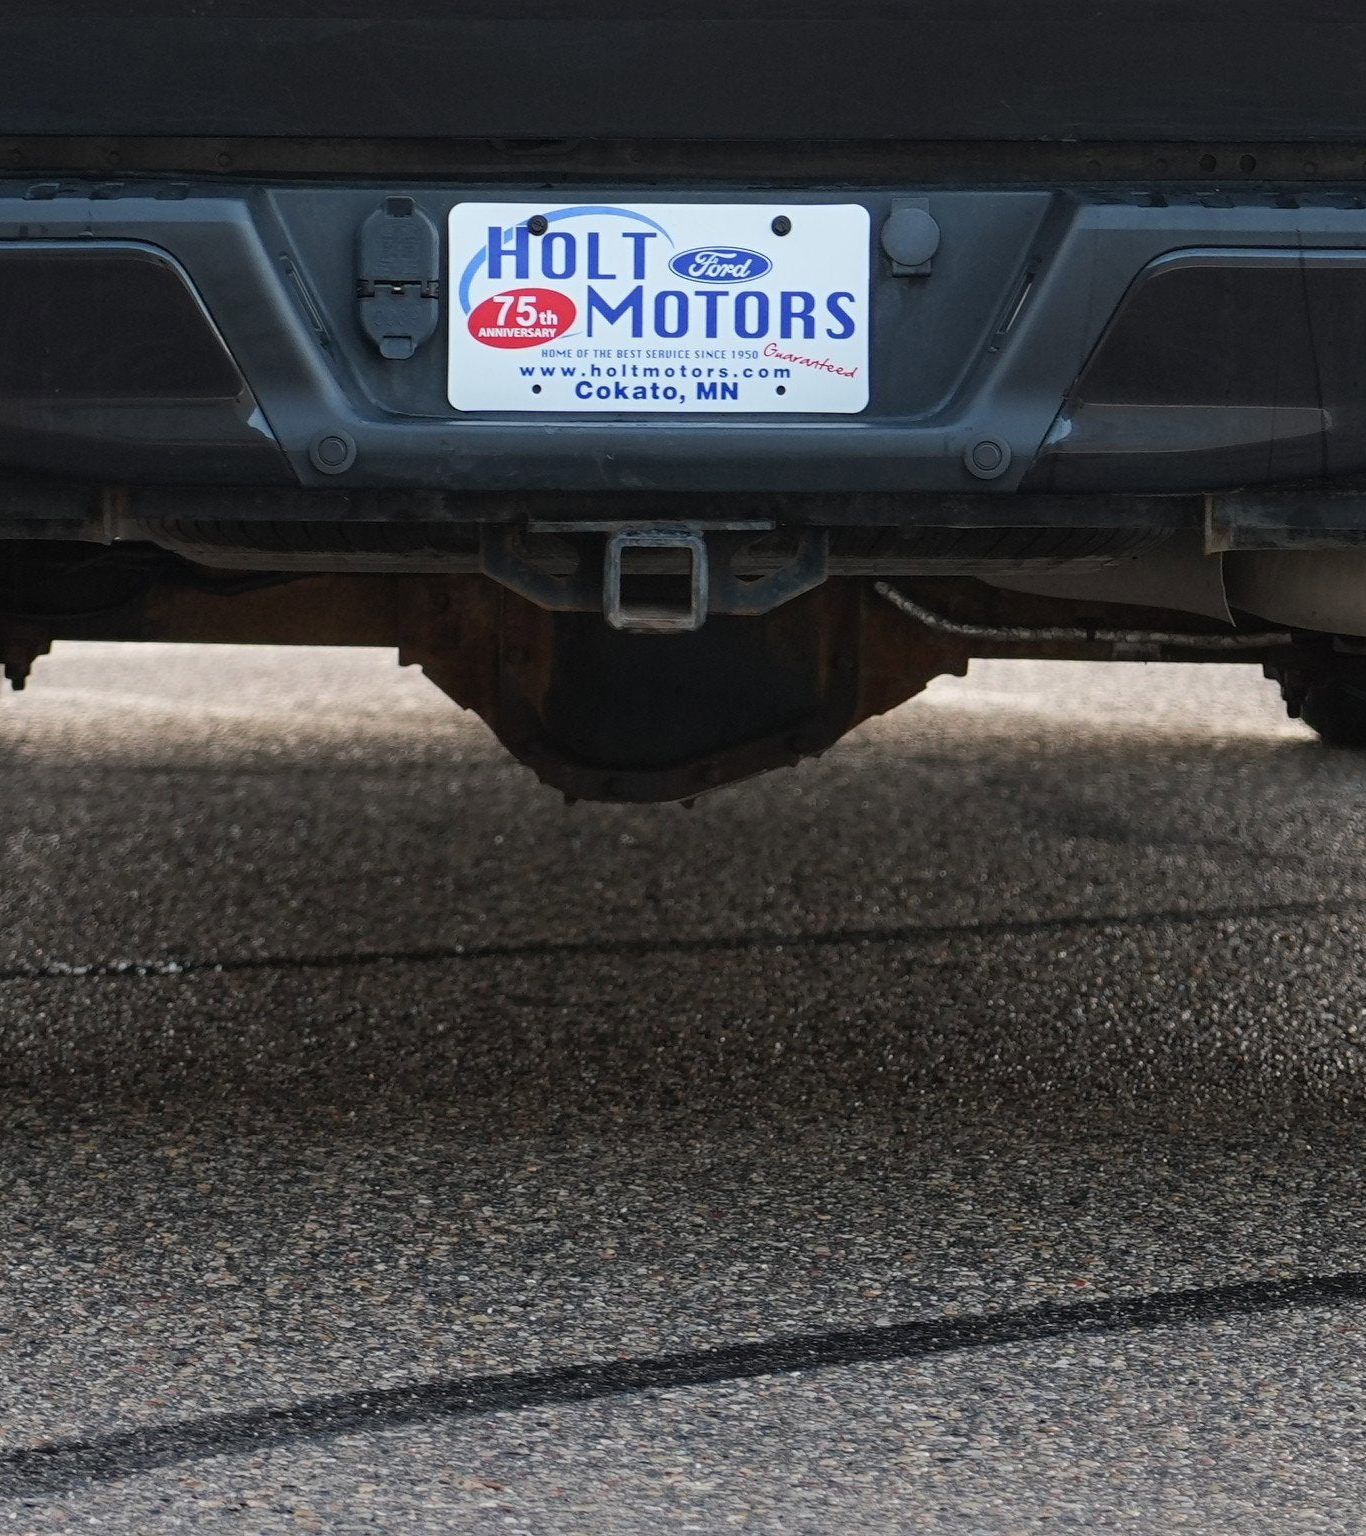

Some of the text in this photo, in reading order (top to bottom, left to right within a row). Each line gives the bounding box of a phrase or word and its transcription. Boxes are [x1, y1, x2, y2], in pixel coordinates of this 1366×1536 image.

[488, 226, 657, 280] HOLT
[688, 250, 753, 278] Ford
[492, 295, 559, 327] 75th
[587, 285, 856, 340] MOTORS
[477, 327, 557, 339] ANNIVERSARY
[541, 349, 759, 359] HOME OF THE BEST SERVICE SINCE 1950
[763, 342, 858, 379] Guaranteed
[519, 364, 791, 378] www.holtmotors.com
[575, 380, 739, 404] Cokato, MN
